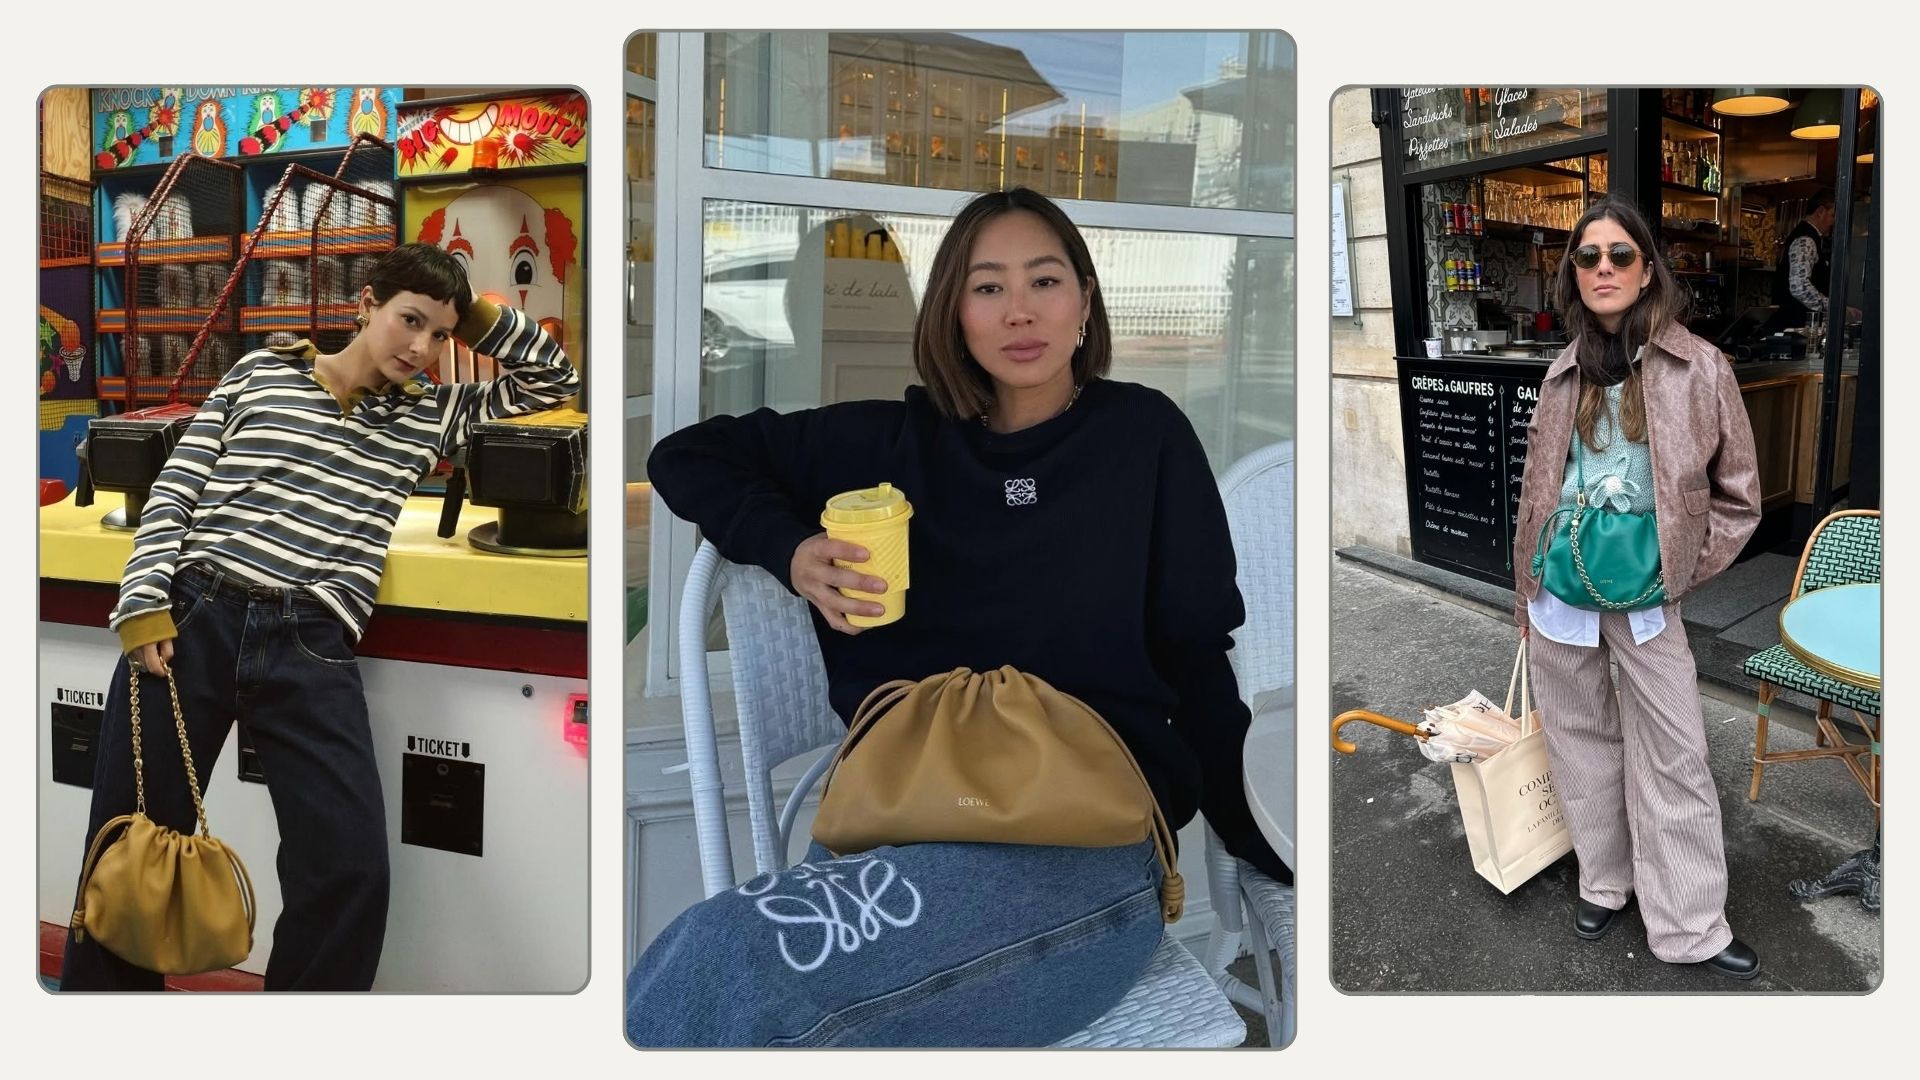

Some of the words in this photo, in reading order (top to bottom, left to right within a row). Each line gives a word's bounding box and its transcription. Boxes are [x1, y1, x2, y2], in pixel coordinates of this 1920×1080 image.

[98, 88, 155, 112] KNOCK
[1495, 88, 1528, 117] Glaces
[1403, 103, 1453, 129] Sandwichs
[1494, 115, 1538, 140] Salades
[398, 120, 438, 159] BIG
[500, 103, 586, 148] MOUTH
[1408, 137, 1449, 161] Pizzettes
[843, 278, 863, 296] de
[1412, 375, 1444, 392] CRÊPES
[1445, 384, 1450, 392] &
[1450, 380, 1494, 397] GAUFRES
[64, 689, 96, 706] TICKET
[417, 737, 460, 757] TICKET
[958, 796, 991, 807] LOEWE
